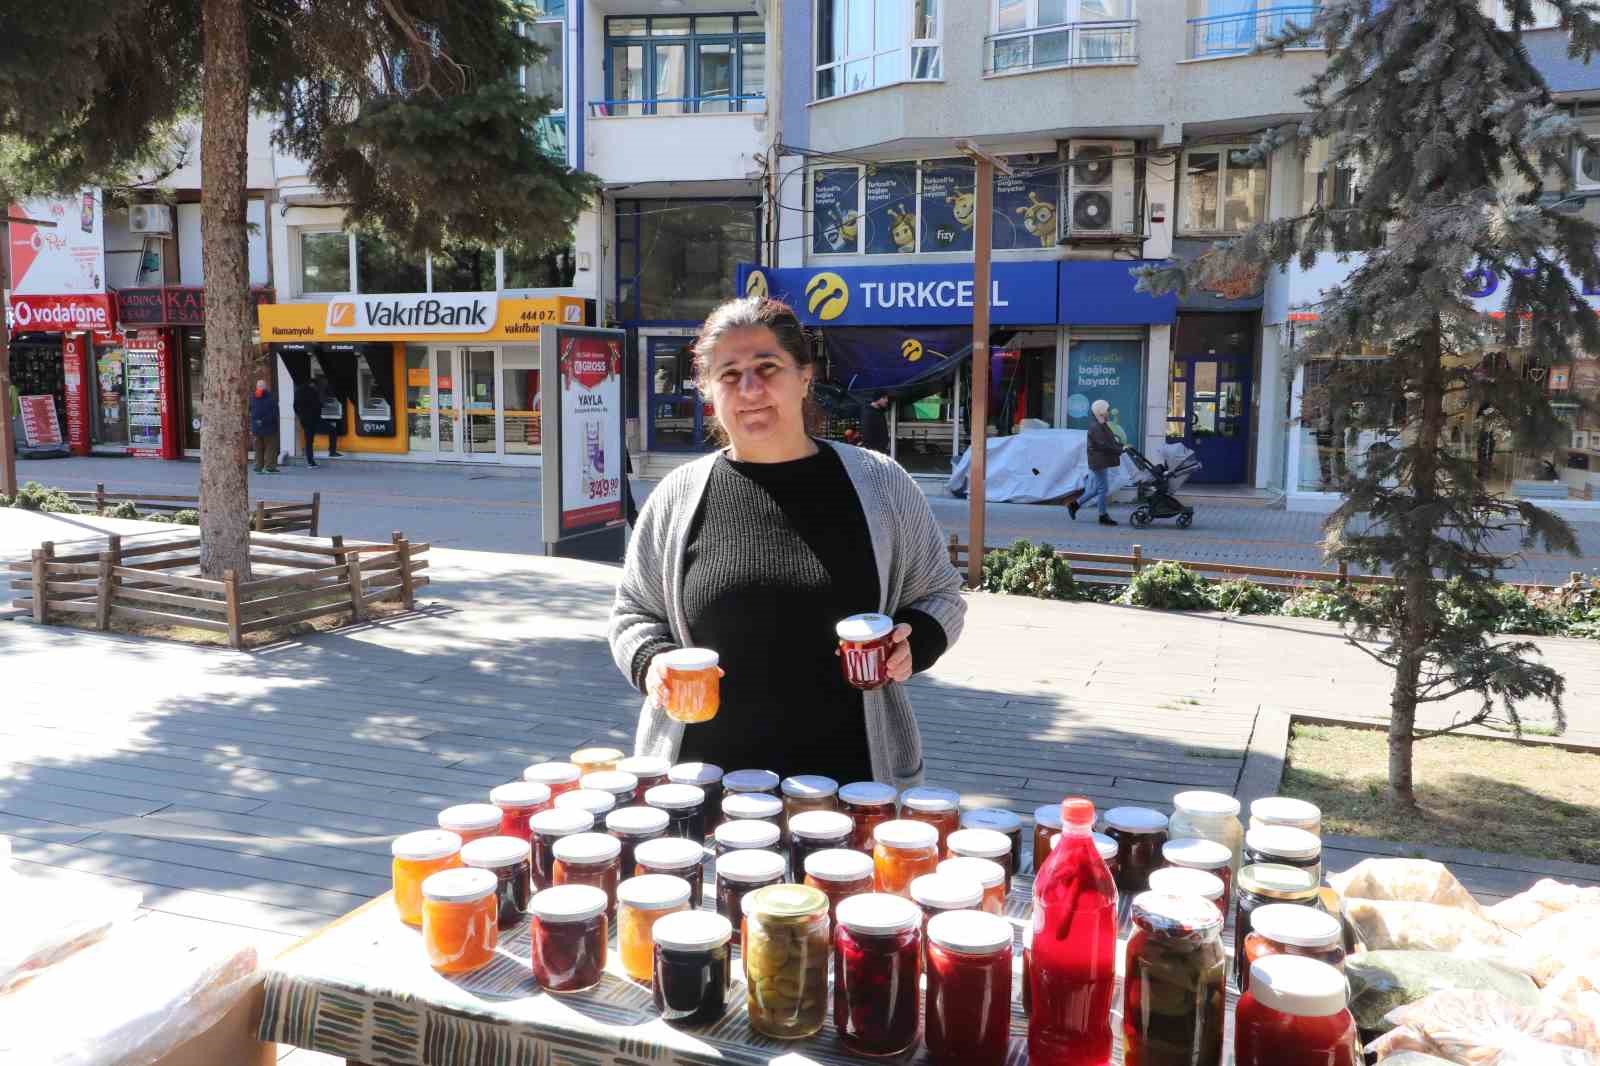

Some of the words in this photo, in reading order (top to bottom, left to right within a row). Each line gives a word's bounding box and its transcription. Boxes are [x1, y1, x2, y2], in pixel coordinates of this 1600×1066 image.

[937, 229, 955, 242] fizy
[859, 280, 1009, 308] TURKCEL
[32, 302, 105, 322] vodafone
[520, 310, 537, 321] 444
[539, 310, 545, 320] 0
[582, 361, 606, 372] GROSS
[1078, 364, 1116, 376] bağlan
[1078, 376, 1120, 387] hayata!
[578, 395, 604, 406] YAYLA
